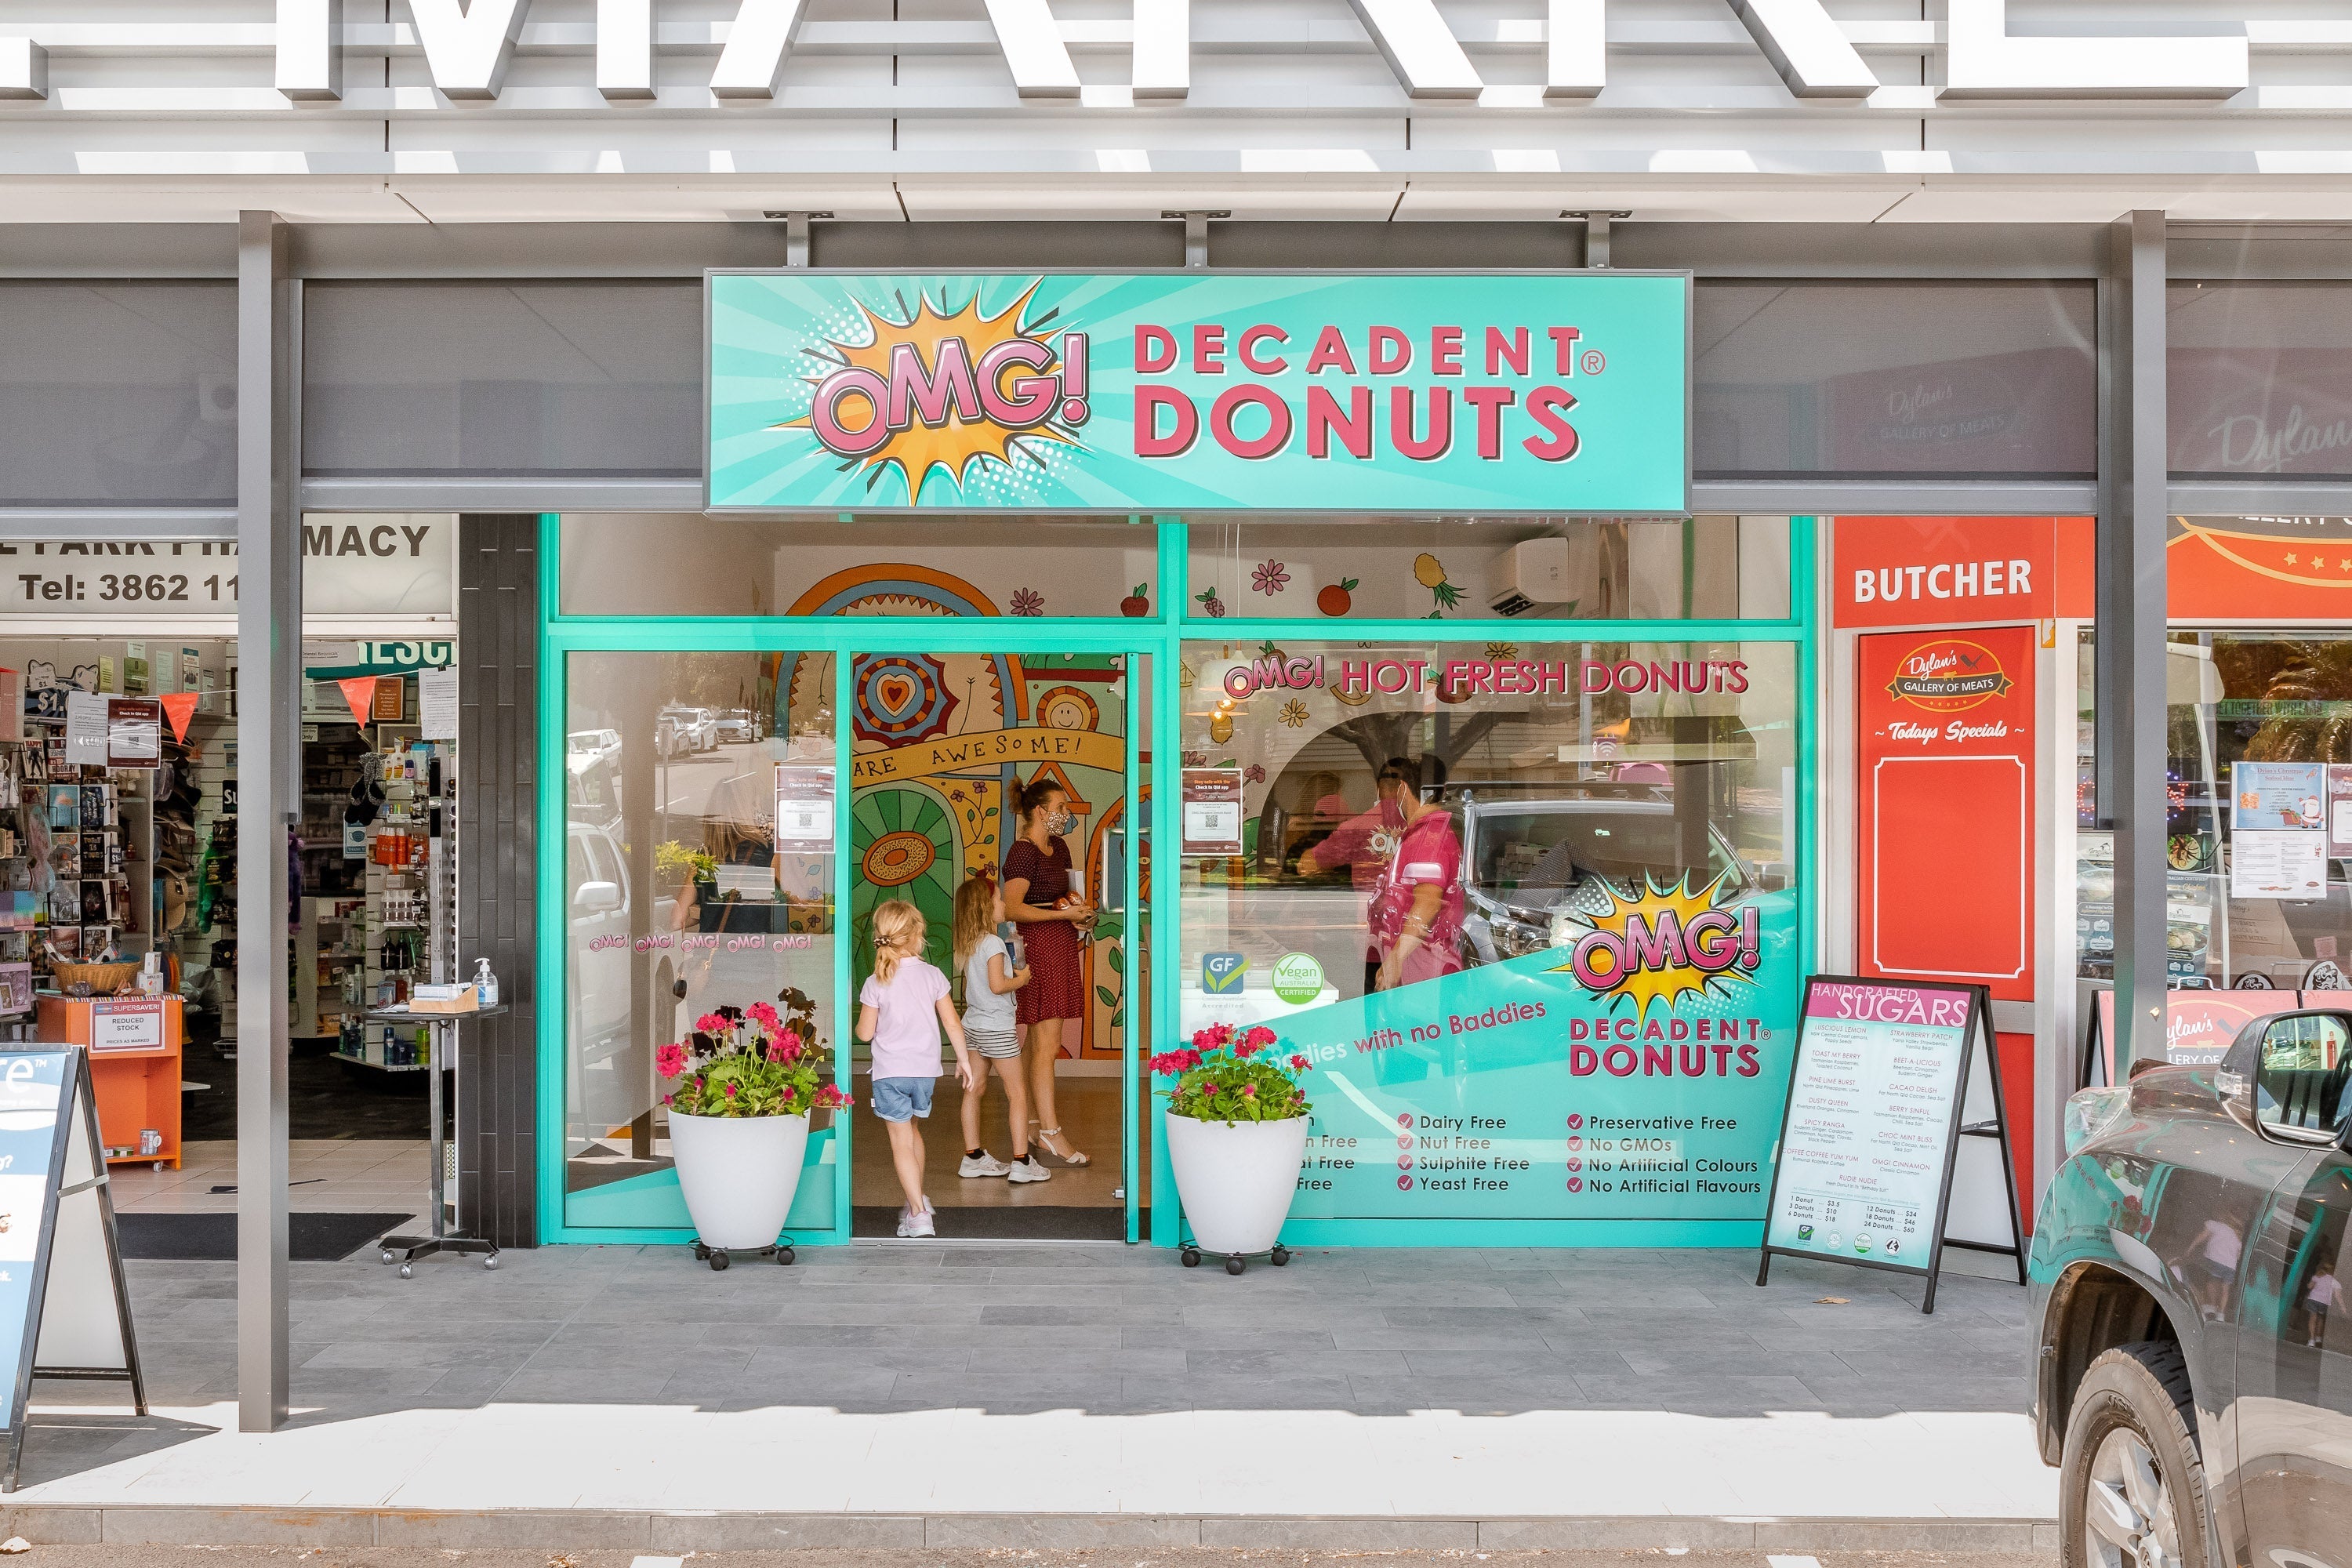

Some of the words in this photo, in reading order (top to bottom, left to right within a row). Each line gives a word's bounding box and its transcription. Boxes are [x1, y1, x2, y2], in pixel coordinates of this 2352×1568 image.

[809, 331, 1091, 460] OMG!
[1134, 384, 1581, 463] DONUTS
[18, 574, 85, 601] Tel:
[99, 574, 189, 601] 3862
[1854, 558, 2032, 604] BUTCHER
[1907, 650, 1957, 681] Dylan's
[1223, 655, 1325, 700] OMG!
[1341, 659, 1430, 695] HOT
[1446, 659, 1568, 695] FRESH
[1581, 659, 1749, 695] DONUTS
[1904, 681, 1944, 692] GALLERY
[1947, 683, 1959, 691] OF
[1962, 678, 1994, 691] MEATS
[1888, 721, 1939, 746] Todays
[1944, 720, 2008, 743] Specials
[853, 757, 897, 777] ARE
[931, 735, 1081, 765] AWESOME!
[590, 934, 630, 953] OMG!
[635, 934, 675, 953] OMG!
[681, 934, 720, 953] OMG!
[727, 934, 766, 953] OMG!
[772, 934, 812, 953] OMG!
[1570, 906, 1762, 993] OMG!
[1209, 957, 1235, 972] GF
[1277, 961, 1317, 979] Vegan
[1811, 983, 1918, 1003] HANDCRAFTED
[1835, 992, 1969, 1027] SUGARS
[1354, 1028, 1403, 1054] with
[1410, 1023, 1441, 1044] no
[1448, 1000, 1547, 1036] Baddies
[1890, 1029, 1930, 1039] STRAWBERRY
[2167, 1012, 2214, 1051] ylan's
[1570, 1044, 1762, 1077] DONUTS
[1889, 1083, 1915, 1092] CACAO
[1419, 1115, 1464, 1131] Dairy
[1471, 1116, 1507, 1129] Free
[1589, 1116, 1694, 1130] Preservative
[1700, 1116, 1737, 1130] Free
[1322, 1135, 1358, 1148] Free
[1419, 1137, 1448, 1149] Nut
[1455, 1137, 1491, 1149] Free
[1589, 1138, 1613, 1152] No
[1619, 1138, 1672, 1152] GMOs
[1782, 1147, 1805, 1156] COFFEE
[1806, 1150, 1828, 1159] COFFEE
[1319, 1156, 1355, 1169] Free
[1419, 1156, 1487, 1172] Sulphite
[1494, 1156, 1530, 1170] Free
[1588, 1159, 1613, 1172] No
[1619, 1158, 1689, 1172] Artificial
[1695, 1158, 1758, 1172] Colours
[1893, 1160, 1931, 1171] CINNAMON
[1297, 1177, 1333, 1190] Free
[1419, 1177, 1466, 1190] Yeast
[1472, 1177, 1509, 1190] Free
[1589, 1179, 1613, 1192] No
[1619, 1179, 1690, 1192] Artificial
[1696, 1179, 1761, 1193] Flavours
